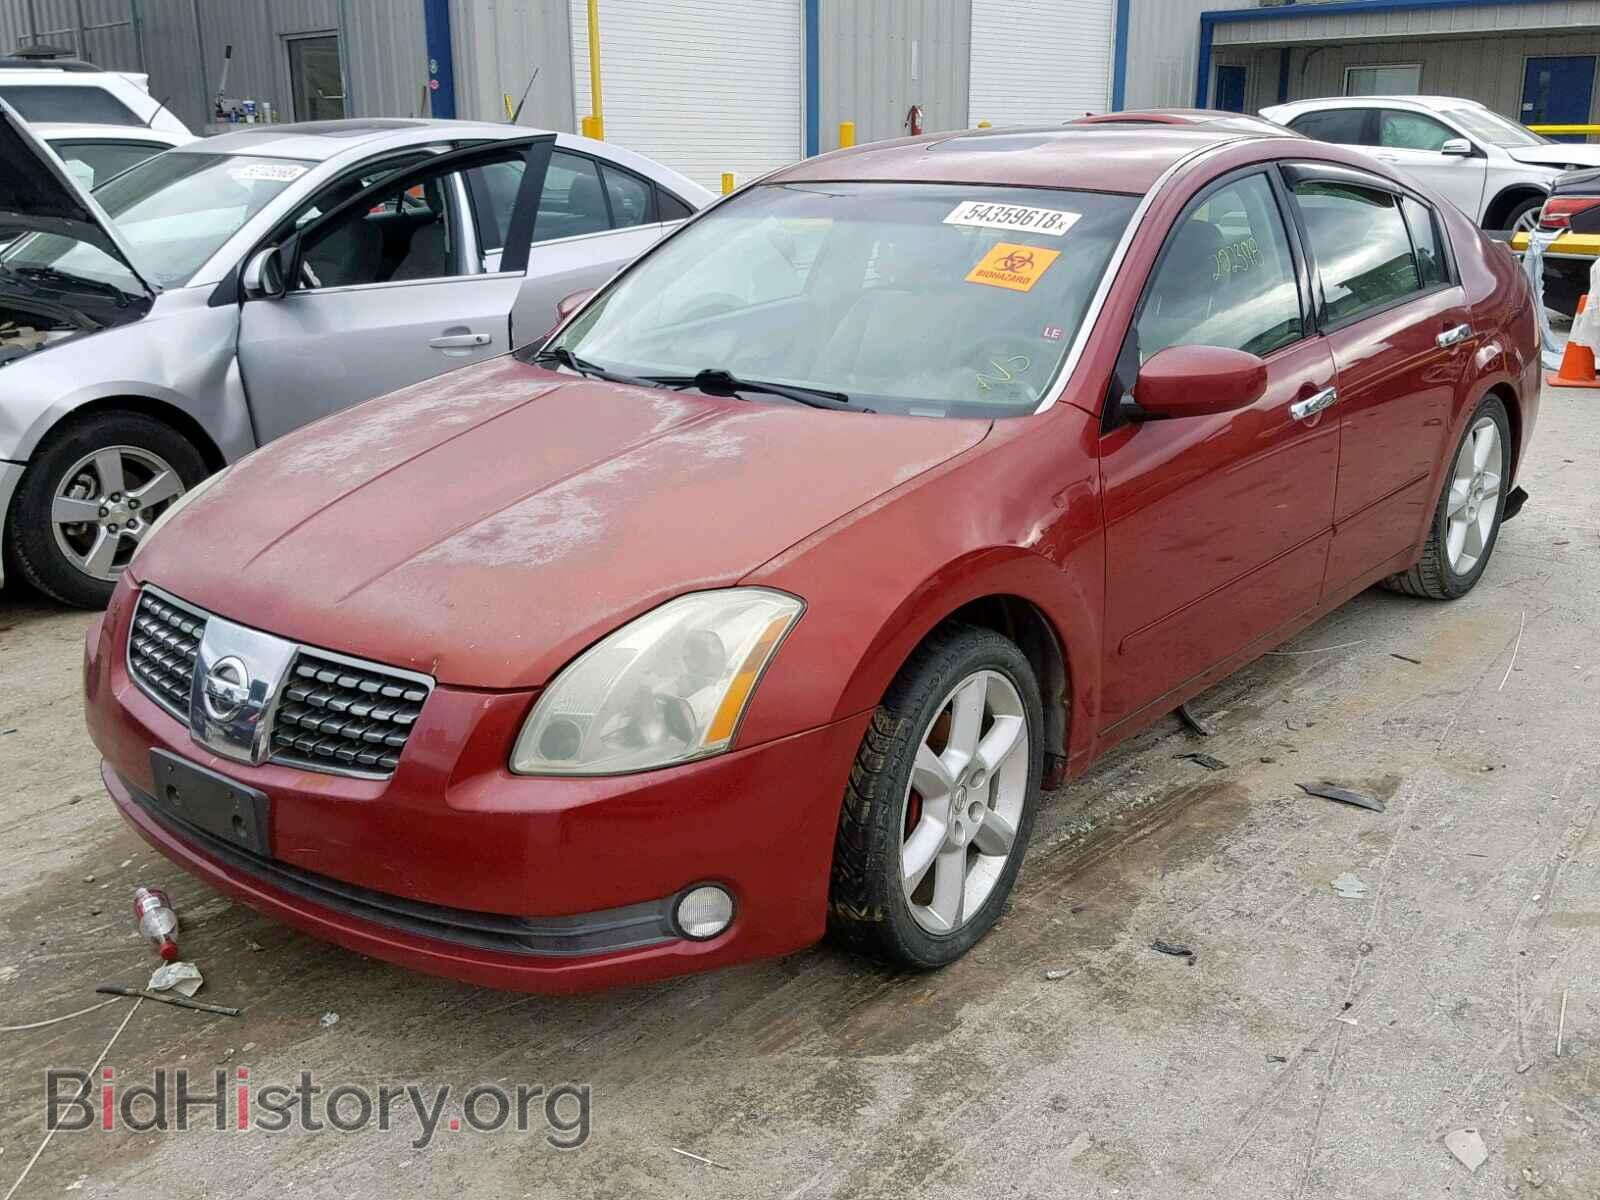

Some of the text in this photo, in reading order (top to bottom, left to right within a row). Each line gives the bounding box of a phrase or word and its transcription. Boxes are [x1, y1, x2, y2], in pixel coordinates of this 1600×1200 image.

[964, 204, 1063, 229] 54359618
[975, 270, 1031, 285] BIOHAZARD
[1043, 327, 1062, 338] LE
